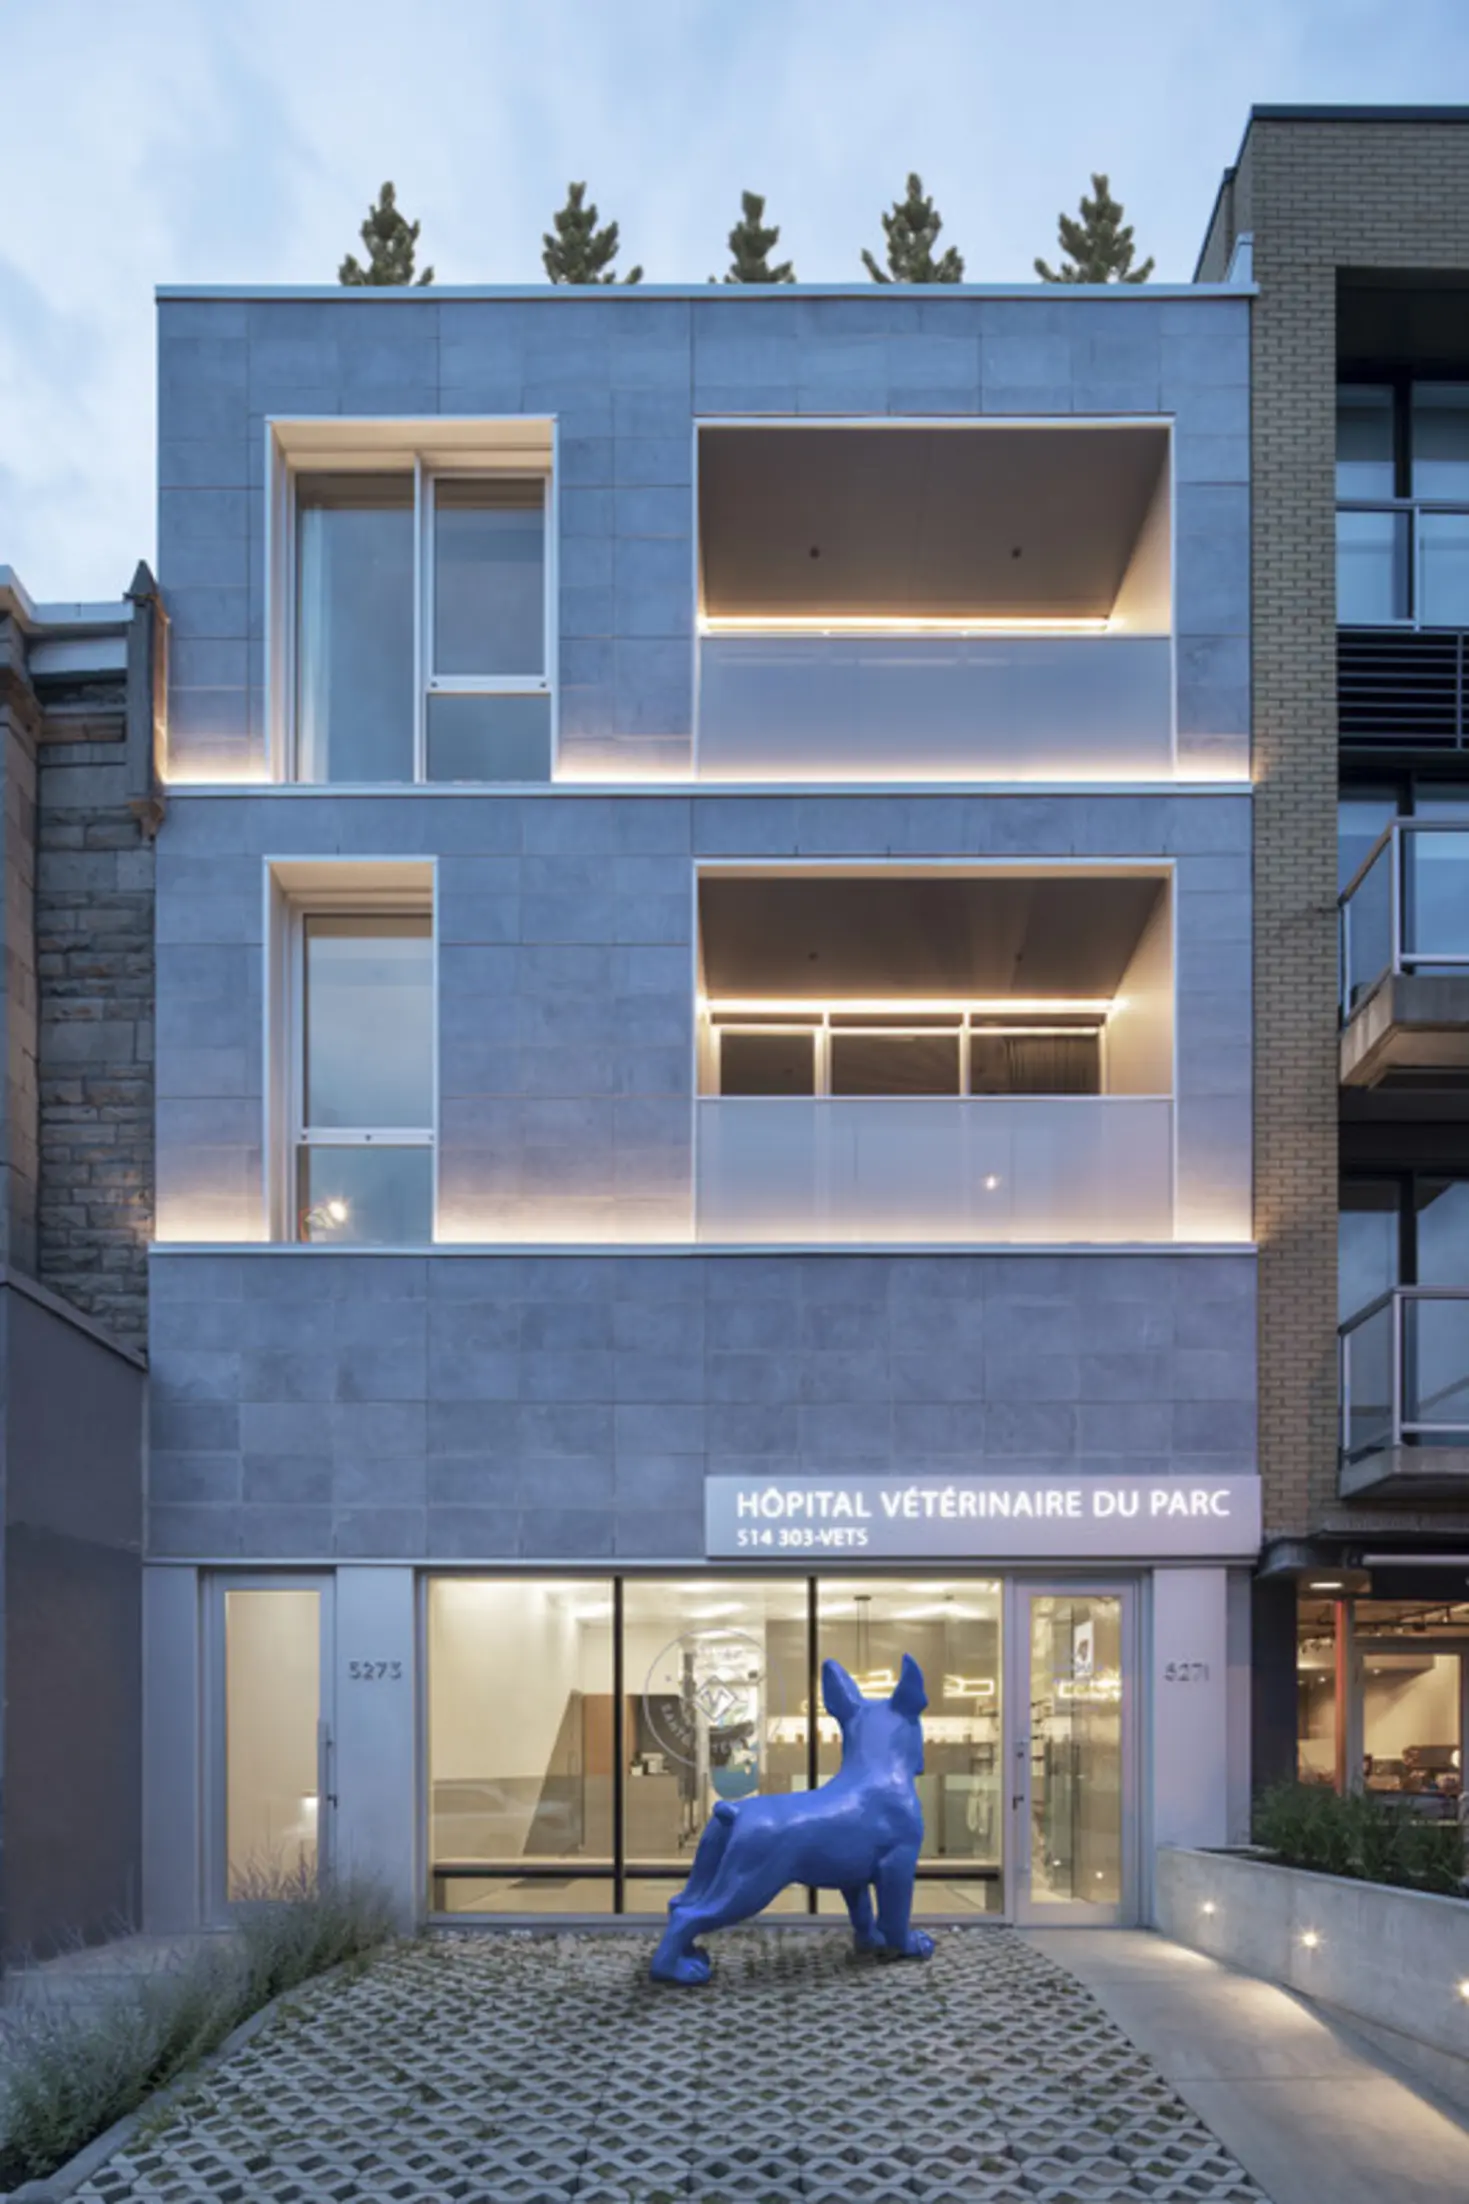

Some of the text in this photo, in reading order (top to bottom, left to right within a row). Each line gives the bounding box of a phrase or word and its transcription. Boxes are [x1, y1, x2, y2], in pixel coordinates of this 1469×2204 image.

[736, 1486, 1231, 1519] HÔPITAL VÉTÉRINAIRE DU PARC
[736, 1527, 869, 1547] 514 303-VETS
[348, 1660, 403, 1681] 5273
